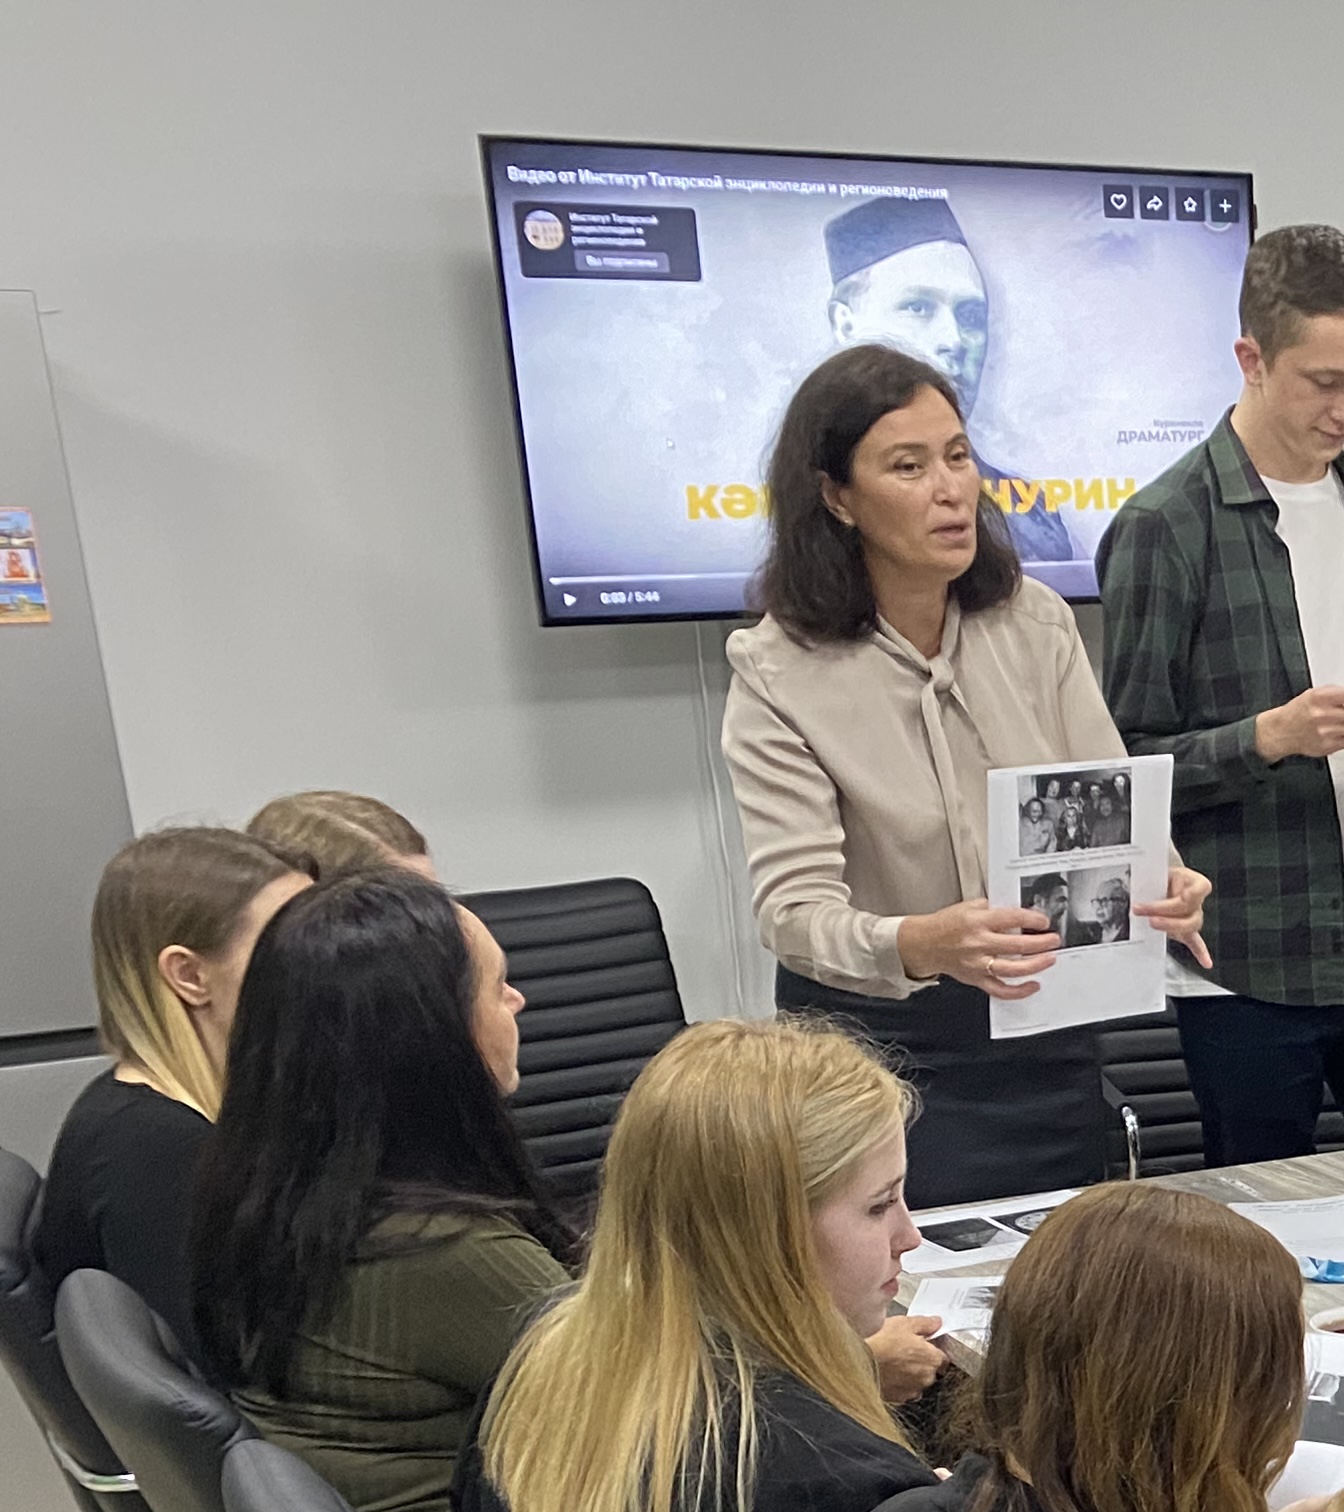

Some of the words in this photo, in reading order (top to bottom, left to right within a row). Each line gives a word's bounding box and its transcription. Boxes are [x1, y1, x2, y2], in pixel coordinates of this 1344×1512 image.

[507, 166, 557, 185] Видео
[558, 171, 576, 184] от
[578, 169, 647, 189] Институт
[648, 172, 723, 191] Татарской
[725, 177, 825, 194] энциклопедии
[828, 182, 837, 194] и
[840, 183, 949, 201] регионоведения
[1116, 430, 1205, 444] ДРАМАТУРГ
